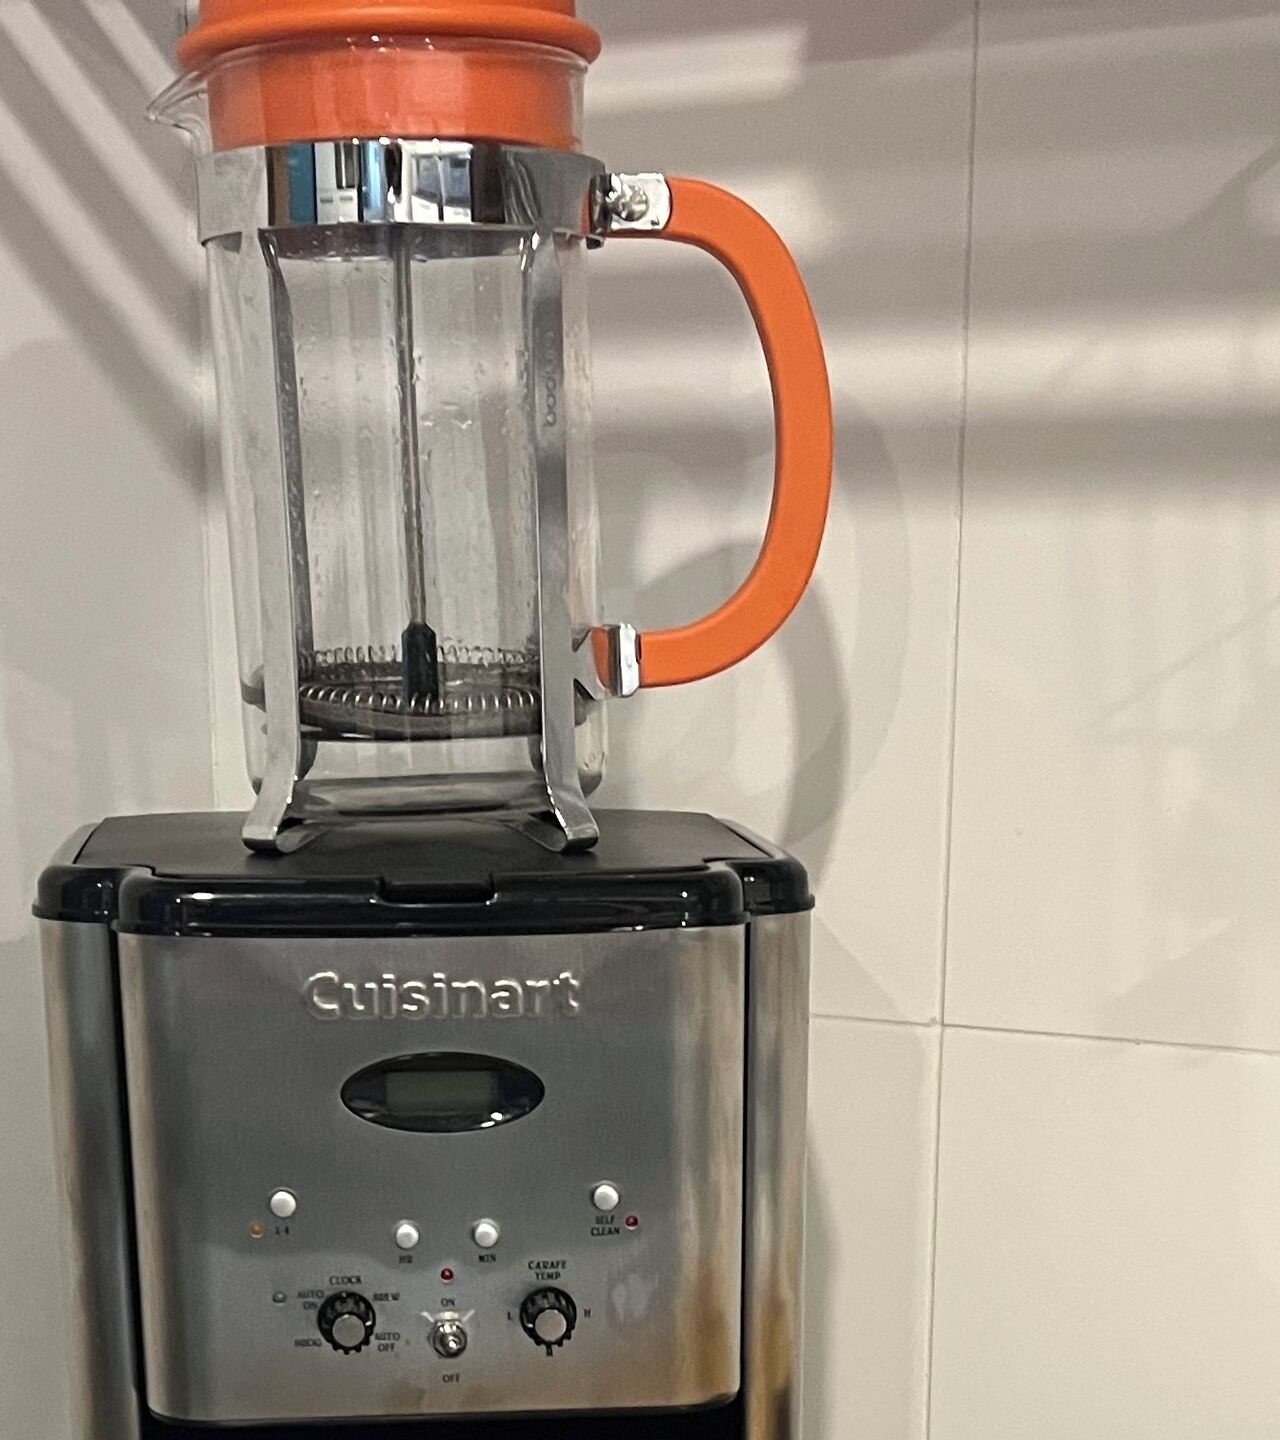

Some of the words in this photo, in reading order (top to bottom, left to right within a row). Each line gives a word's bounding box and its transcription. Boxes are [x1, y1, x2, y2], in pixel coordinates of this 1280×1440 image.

[305, 971, 580, 1020] Cuisinart
[595, 1215, 615, 1225] SELF
[591, 1226, 620, 1237] CLEAN
[478, 1253, 497, 1263] MIN
[528, 1260, 567, 1270] CARAFE
[329, 1275, 362, 1285] CLOCK
[535, 1271, 561, 1281] TEMP
[297, 1290, 324, 1299] AUTO
[373, 1292, 400, 1302] BREW
[303, 1302, 318, 1311] ON
[440, 1298, 455, 1307] ON
[374, 1332, 401, 1342] AUTO
[377, 1343, 395, 1353] OFF
[442, 1374, 460, 1384] OFF
